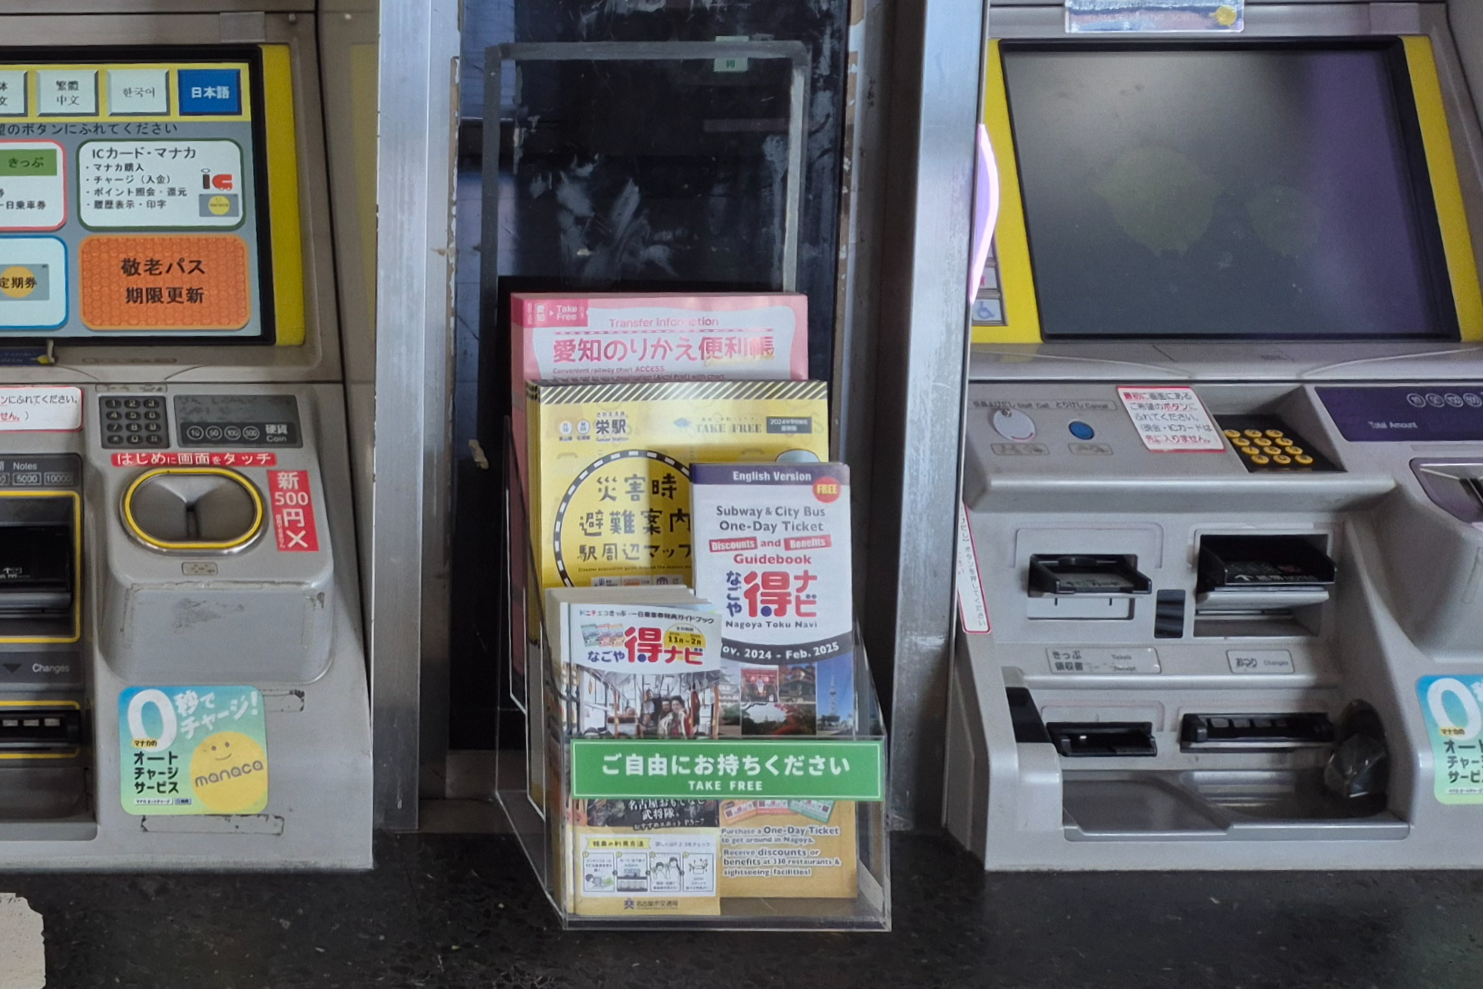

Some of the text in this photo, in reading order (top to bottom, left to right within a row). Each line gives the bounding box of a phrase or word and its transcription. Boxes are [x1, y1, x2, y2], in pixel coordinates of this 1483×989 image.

[123, 87, 155, 97] 한국어
[192, 86, 229, 99] 日本語
[93, 147, 195, 159] ICカード・マナカ
[121, 258, 205, 276] 敬老パス
[126, 287, 204, 304] 期限更新
[554, 336, 774, 363] 愛知のりかえ便利帳
[596, 419, 626, 434] 栄駅
[13, 462, 37, 470] Notes
[115, 452, 273, 467] はじめに画面をタッチ
[278, 472, 298, 489] 新
[733, 471, 811, 482] English Version
[598, 471, 679, 504] 災害時
[817, 484, 837, 494] FREE
[275, 492, 308, 505] 500
[283, 509, 304, 527] 円
[717, 506, 825, 519] Subway & City Bus
[720, 521, 823, 534] One-Day Ticket
[734, 554, 811, 564] Guidebook
[726, 621, 762, 629] Nagoya
[32, 663, 67, 673] Changes
[134, 751, 178, 765] オート
[603, 753, 850, 776] ご自由にお持ちください
[135, 767, 178, 780] チャージ
[195, 758, 264, 787] manaca
[135, 781, 178, 794] サービス
[688, 781, 762, 790] TAKE FREE
